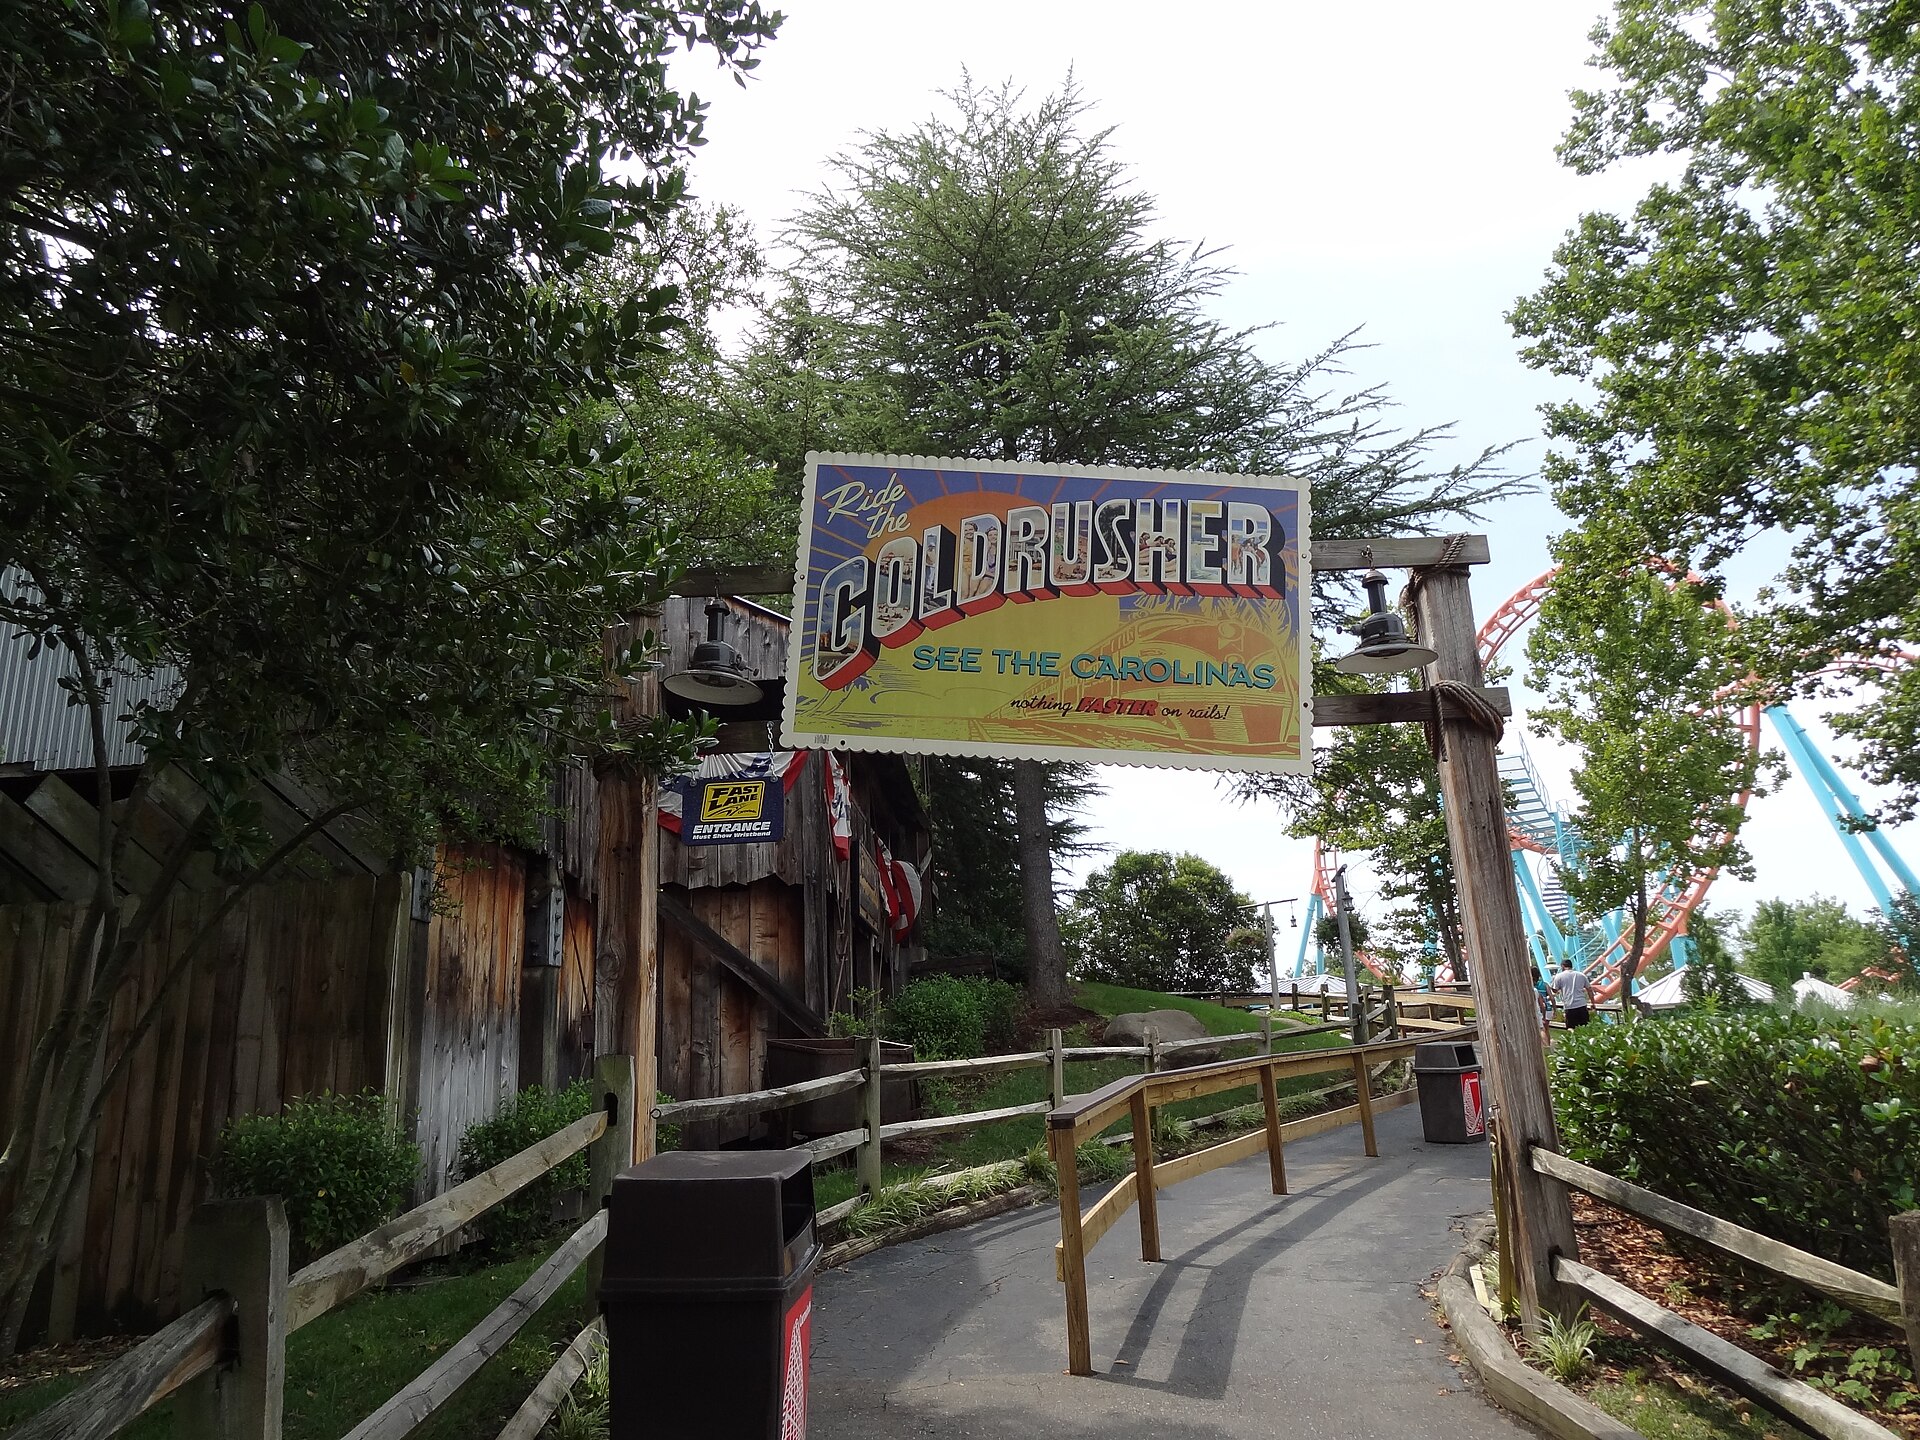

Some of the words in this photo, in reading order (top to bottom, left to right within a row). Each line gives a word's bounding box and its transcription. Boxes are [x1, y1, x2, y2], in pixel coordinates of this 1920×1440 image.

[821, 472, 906, 524] Ride
[866, 502, 911, 539] the
[812, 498, 1281, 688] GOLDRUSHER
[912, 644, 983, 673] SEE
[992, 648, 1061, 677] THE
[1070, 652, 1276, 689] CAROLINAS
[1010, 695, 1074, 717] nothing
[1075, 696, 1159, 717] FASTER
[1161, 706, 1183, 717] on
[1187, 704, 1230, 720] rails!
[708, 794, 758, 812] LANE
[712, 786, 759, 799] FAST
[693, 822, 771, 834] ENTRANCE
